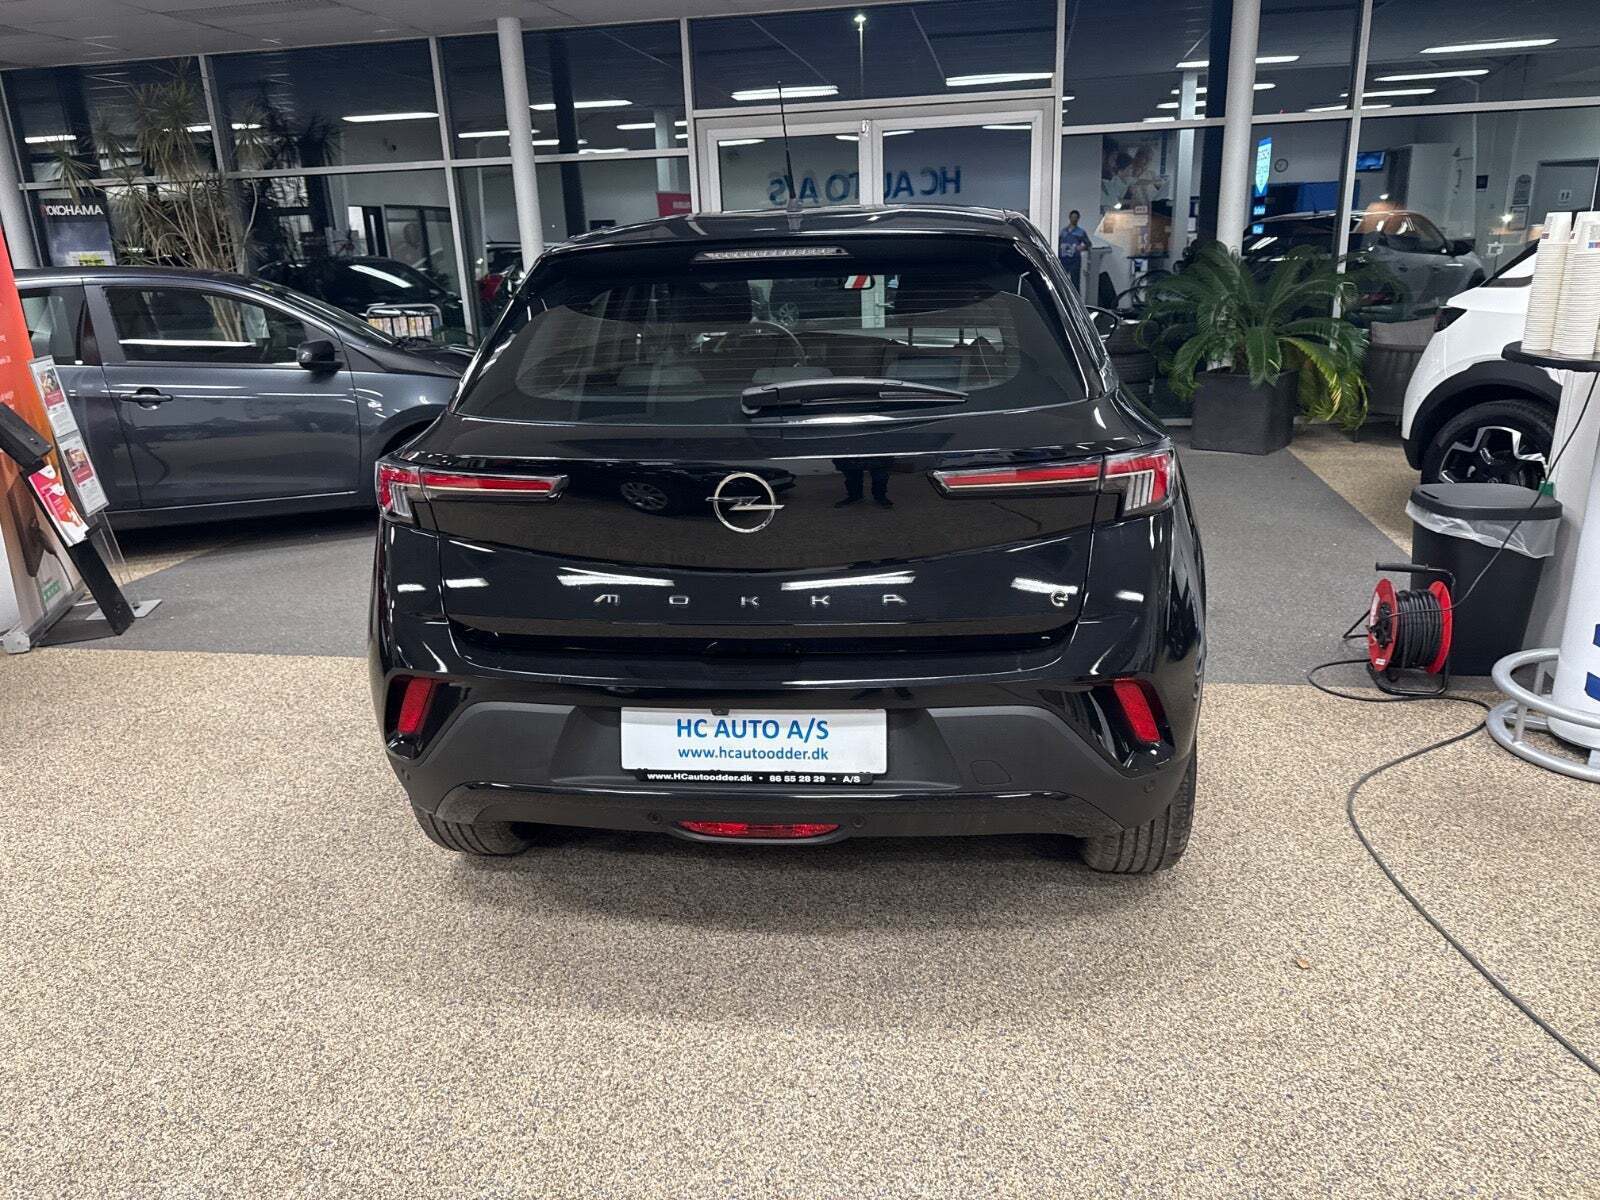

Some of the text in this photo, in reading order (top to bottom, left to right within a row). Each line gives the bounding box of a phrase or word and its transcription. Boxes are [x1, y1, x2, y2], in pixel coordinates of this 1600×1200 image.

[593, 593, 907, 606] MOKKA
[676, 717, 829, 743] HC AUTO A/S
[678, 746, 829, 760] www.hcautoodder.dk
[646, 772, 753, 782] www.HCautoodder.dk
[783, 774, 797, 783] 55
[798, 775, 811, 783] 28
[812, 775, 826, 783] 29
[842, 775, 861, 784] A/S
